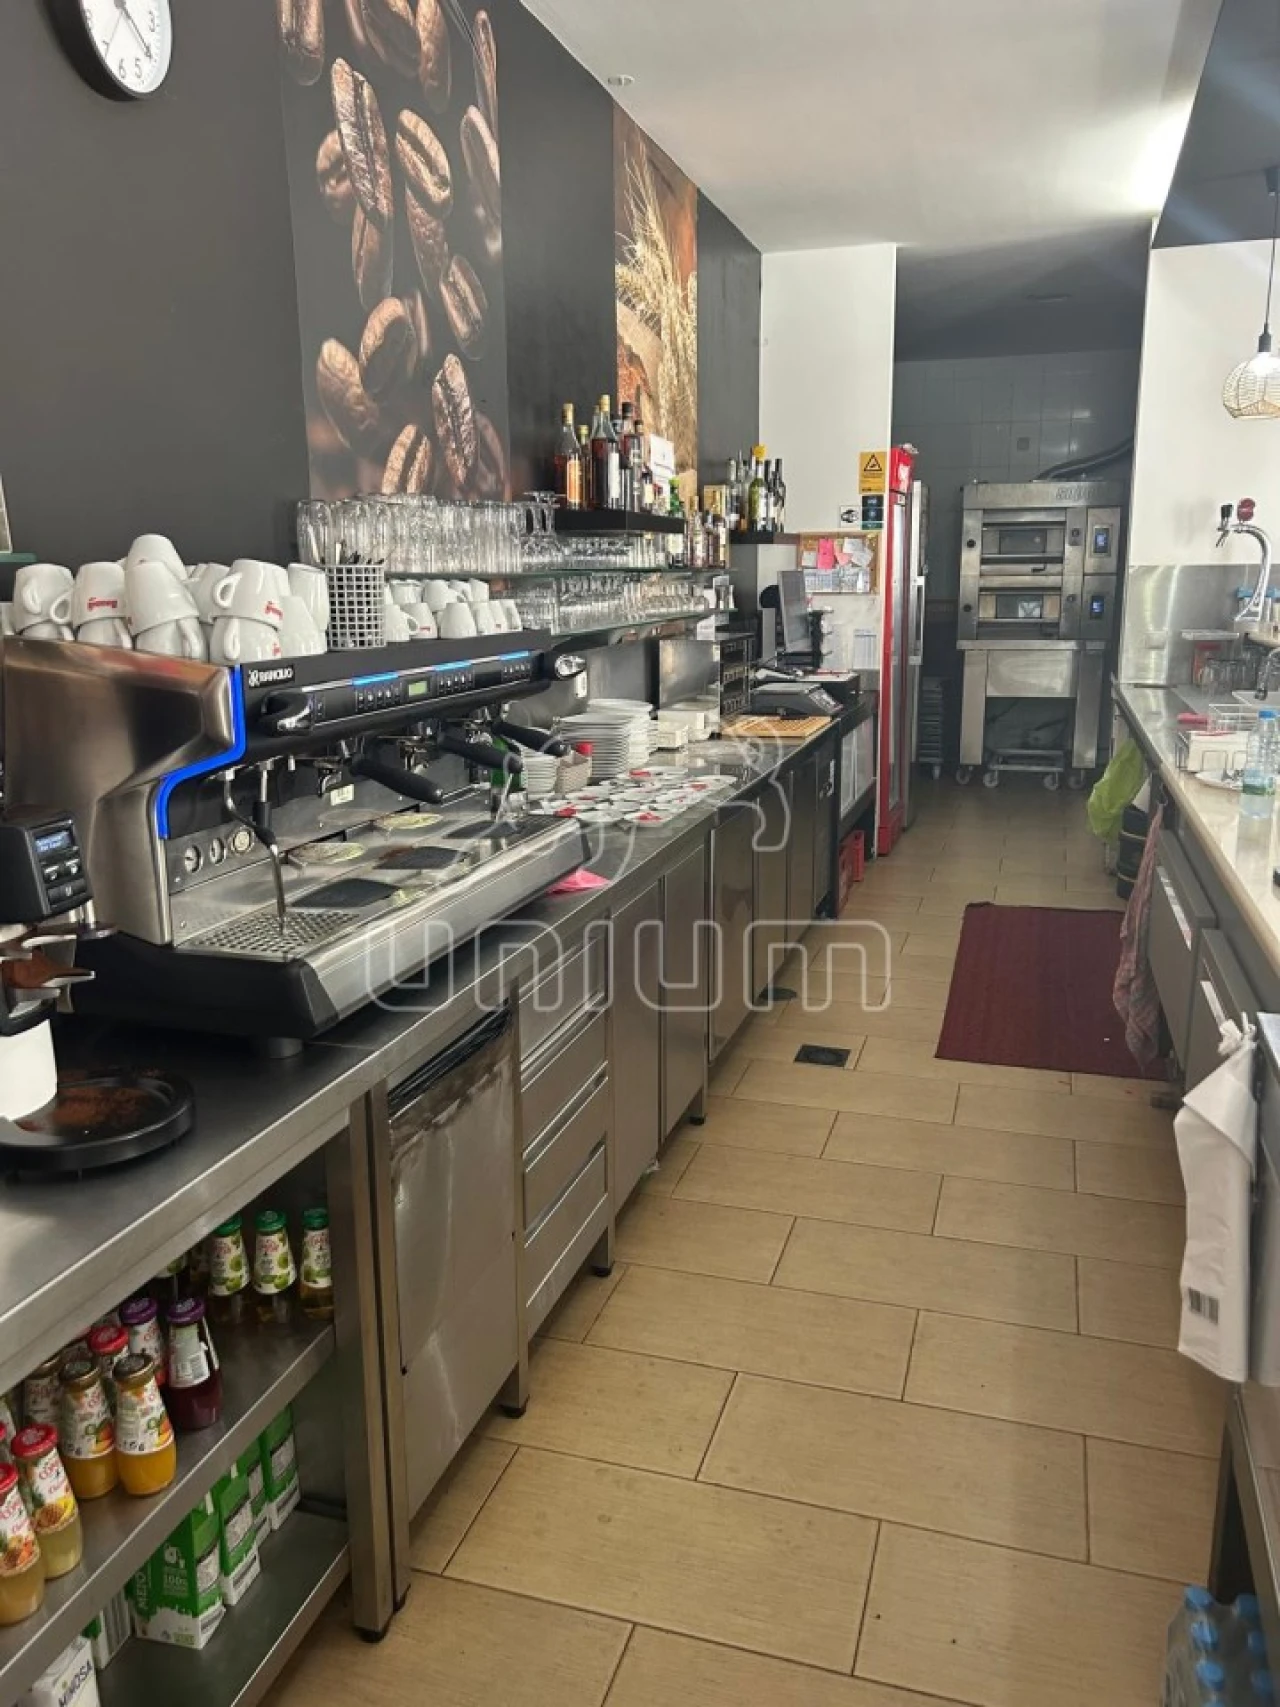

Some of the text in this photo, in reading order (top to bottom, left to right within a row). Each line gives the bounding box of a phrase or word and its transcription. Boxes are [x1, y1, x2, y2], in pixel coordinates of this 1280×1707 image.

[148, 10, 156, 33] 3
[118, 58, 127, 79] 6
[134, 57, 143, 79] 5
